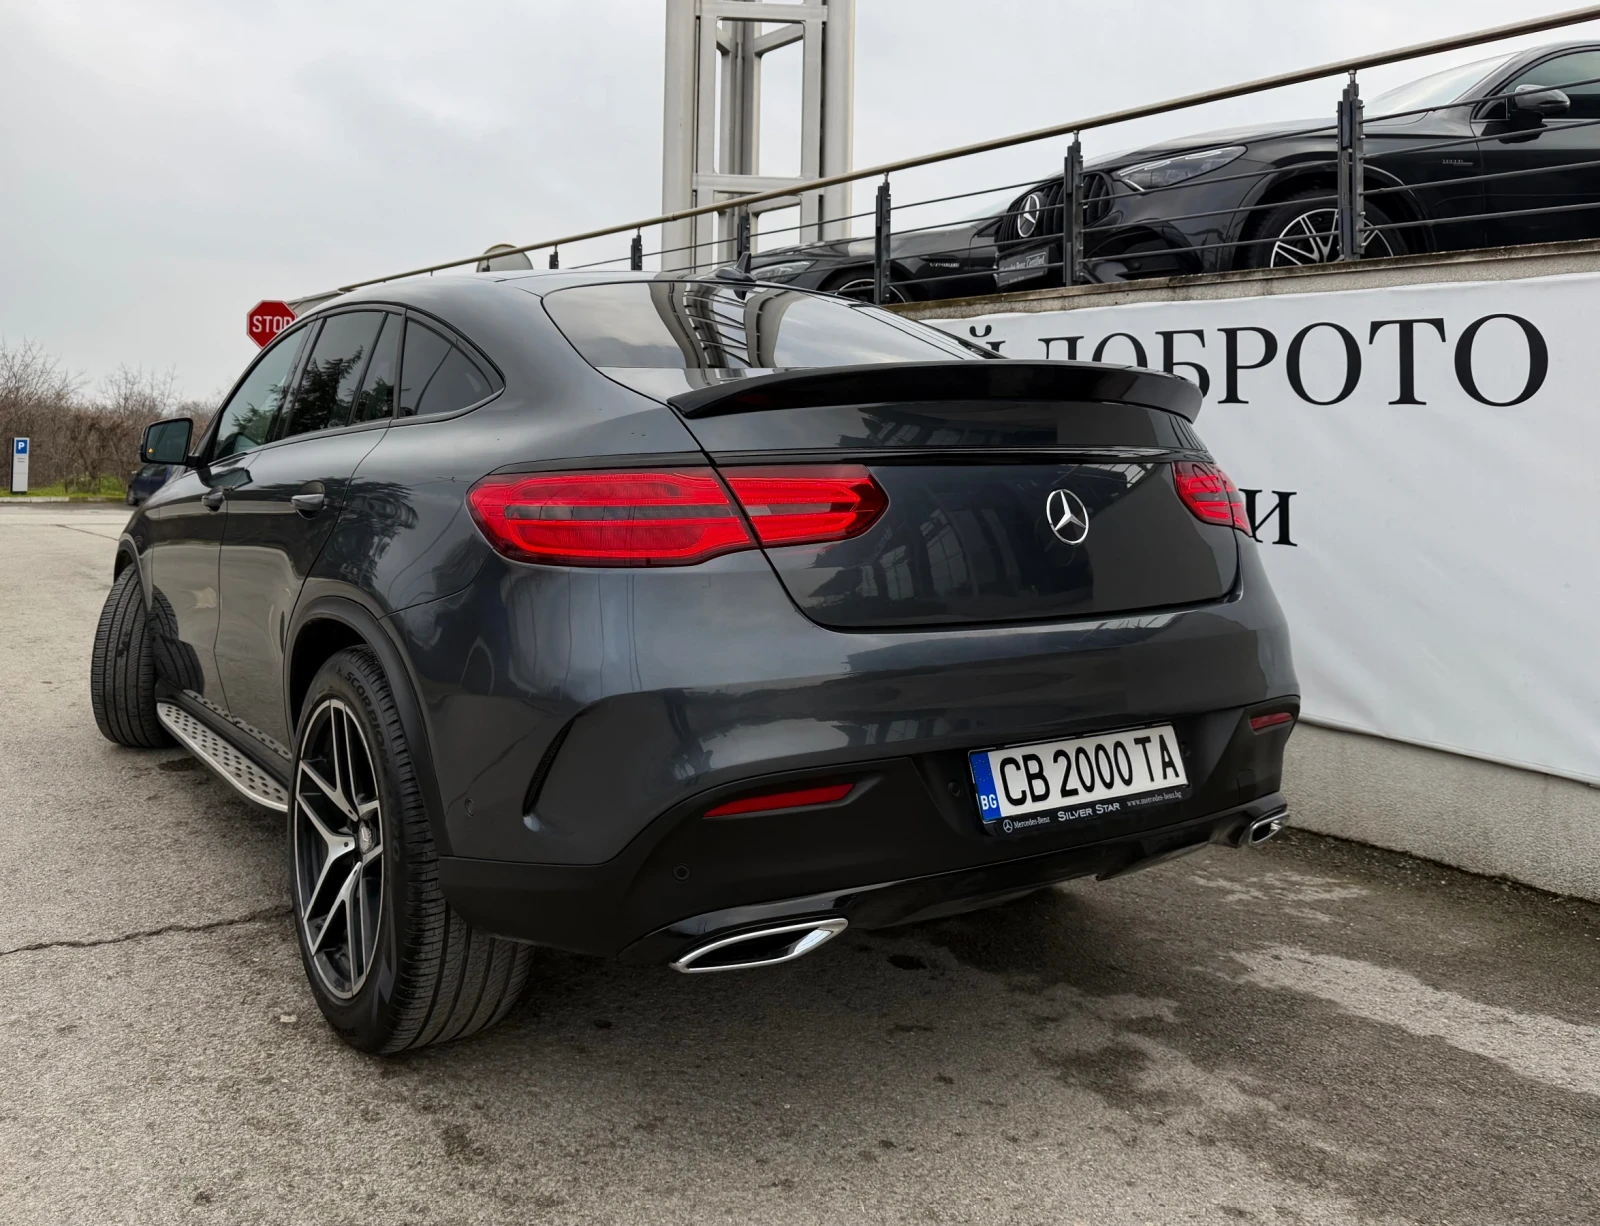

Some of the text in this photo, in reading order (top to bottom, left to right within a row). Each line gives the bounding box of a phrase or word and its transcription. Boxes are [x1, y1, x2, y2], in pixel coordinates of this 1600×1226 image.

[18, 441, 25, 450] P
[1000, 733, 1180, 806] CB 2000 TA
[980, 793, 998, 810] BG
[1126, 790, 1183, 807] www.mercedes-benz.bg
[1013, 816, 1051, 829] Mercedes-Benz
